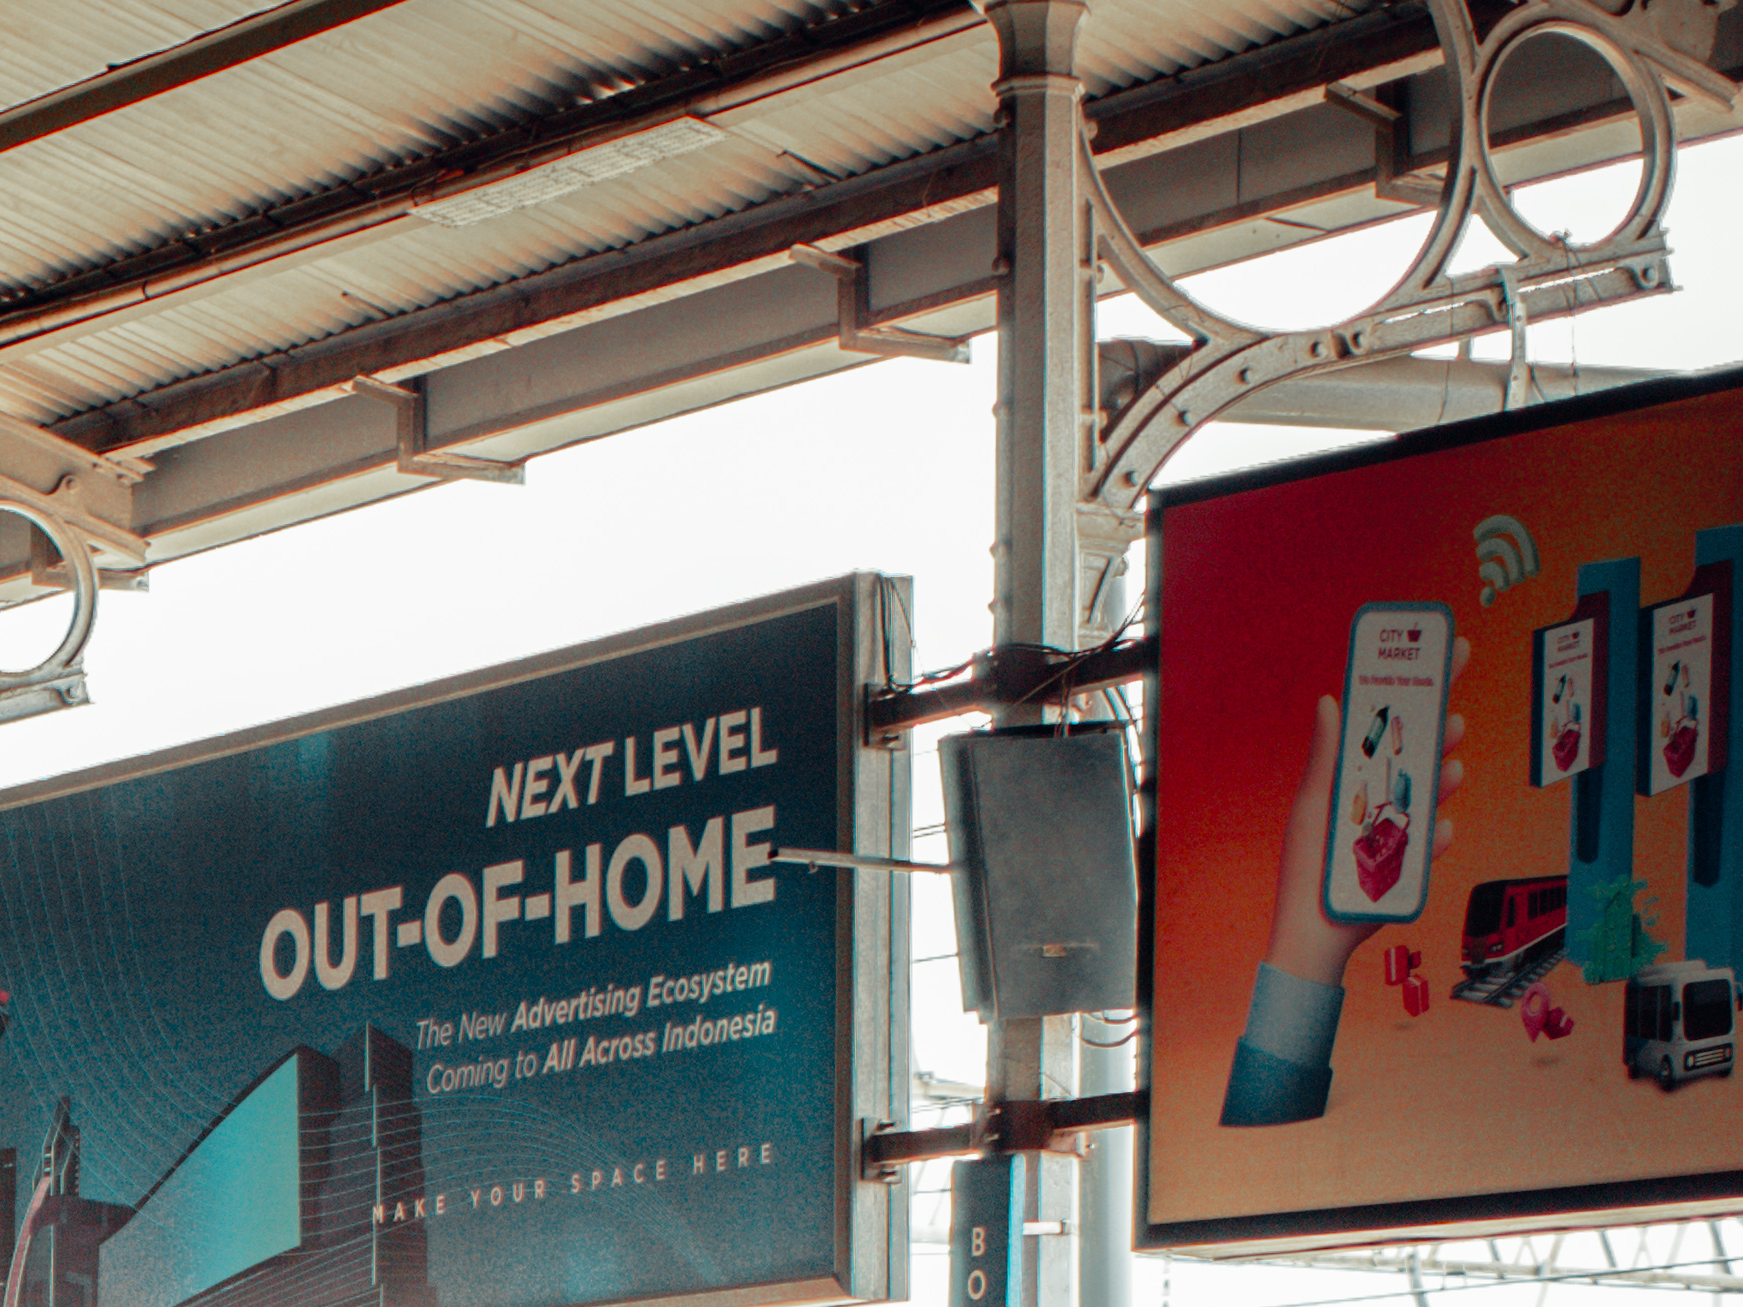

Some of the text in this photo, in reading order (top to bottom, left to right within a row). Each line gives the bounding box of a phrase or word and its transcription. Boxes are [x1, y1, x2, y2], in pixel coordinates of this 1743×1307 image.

[1377, 647, 1421, 660] MARKET
[1379, 629, 1404, 642] CITY
[485, 706, 778, 829] NEXT LEVEL
[258, 803, 777, 1001] OUT-OF-HOME
[416, 960, 772, 1050] The New Advertising Ecosystem
[427, 1004, 777, 1095] Coming to All Across Indonesia
[372, 1142, 773, 1225] MAKE YOUR SPACE HERE
